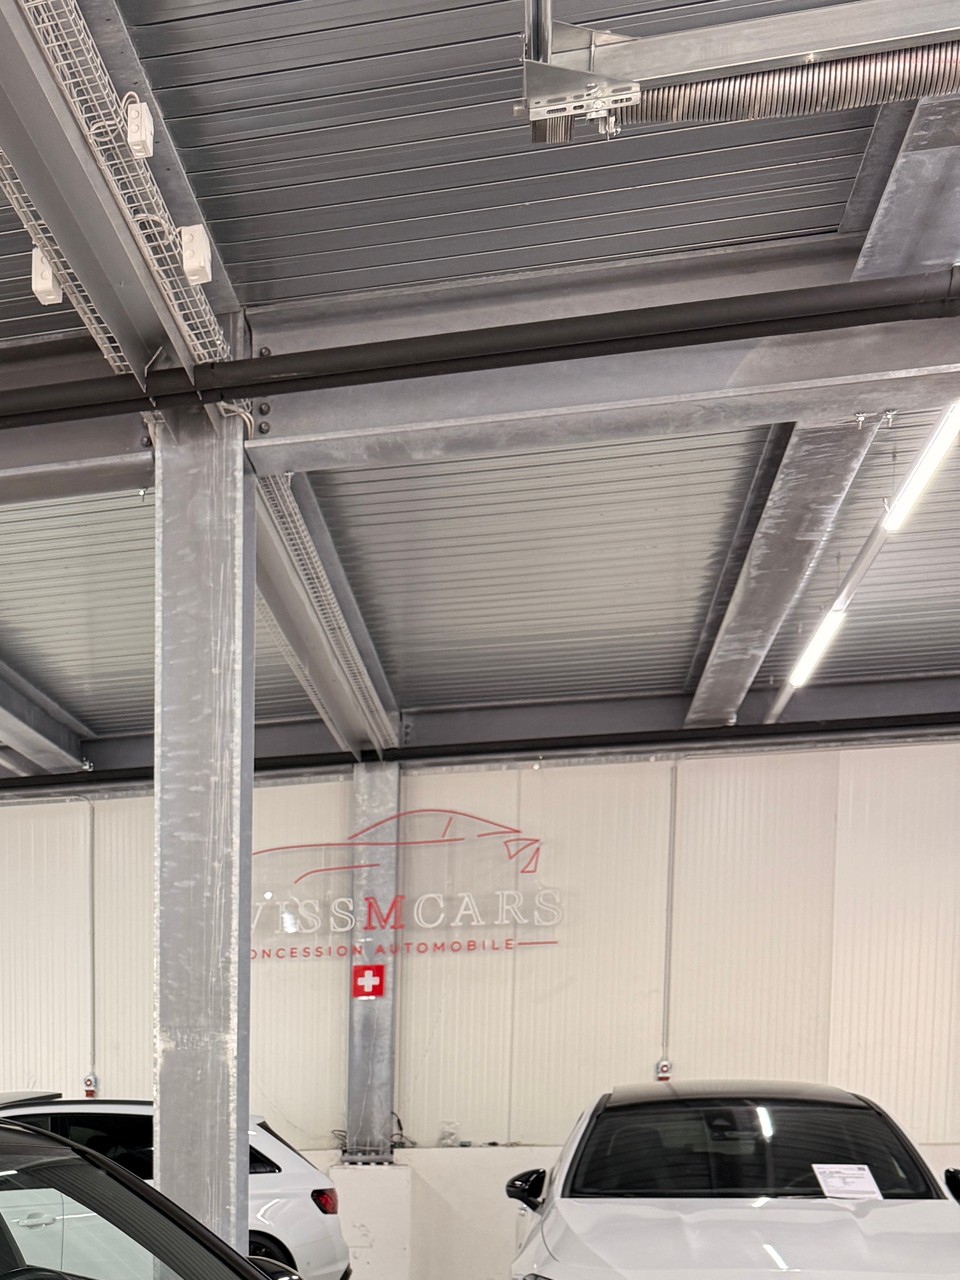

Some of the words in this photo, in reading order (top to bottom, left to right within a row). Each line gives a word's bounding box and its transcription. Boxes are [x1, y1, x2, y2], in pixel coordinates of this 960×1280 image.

[251, 886, 562, 935] ISSMCARS
[251, 945, 363, 960] ONCESSION
[374, 938, 514, 956] AUTOMOBILE
